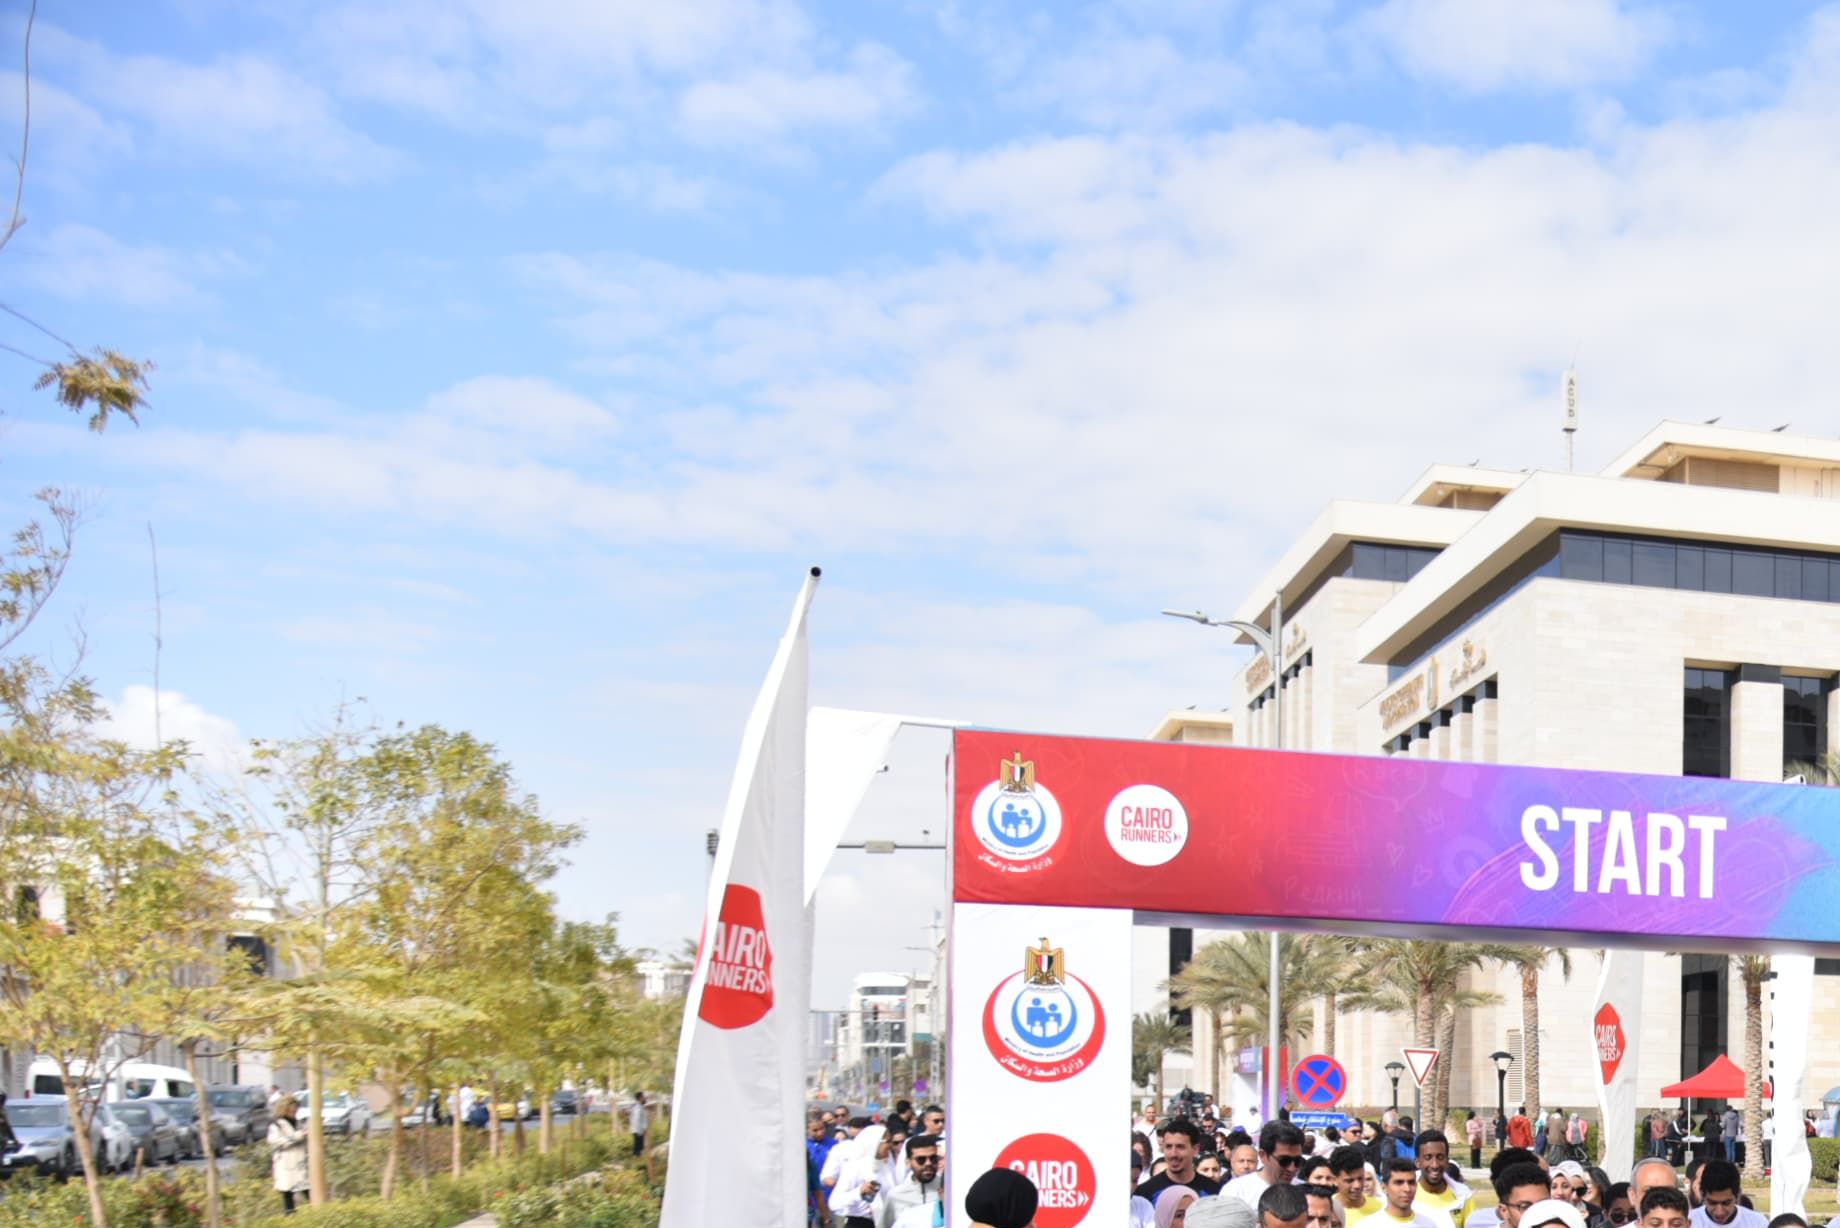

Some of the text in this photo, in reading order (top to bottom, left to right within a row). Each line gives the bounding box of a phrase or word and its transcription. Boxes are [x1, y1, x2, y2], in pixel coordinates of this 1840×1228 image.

[1121, 805, 1173, 830] CAIRO
[1121, 828, 1172, 844] RUNNERS
[1519, 804, 1727, 899] START
[710, 920, 766, 968] AIRO
[705, 959, 767, 994] NNERS
[1039, 1189, 1077, 1208] NERS
